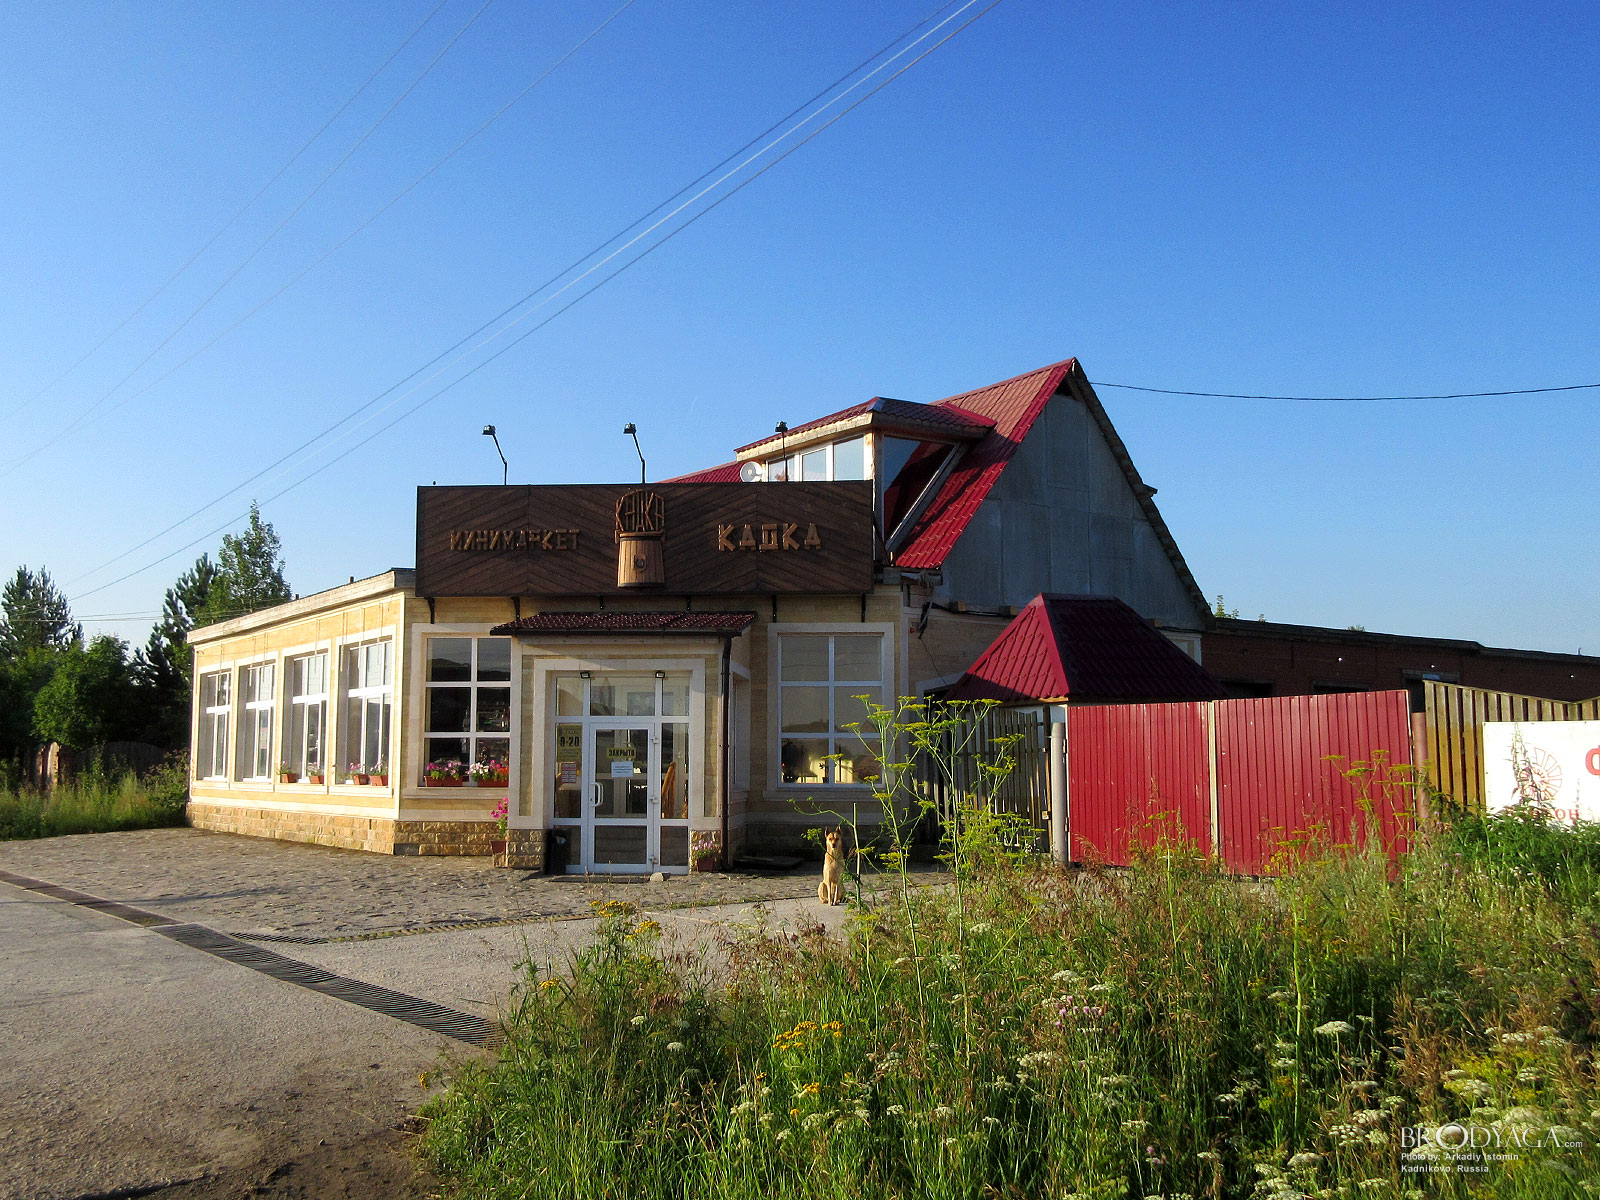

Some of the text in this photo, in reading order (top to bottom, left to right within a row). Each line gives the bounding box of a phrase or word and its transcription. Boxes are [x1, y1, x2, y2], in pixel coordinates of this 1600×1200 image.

[450, 522, 821, 551] МИНИМАРКЕТ КАДКА
[609, 749, 635, 757] ЗАКРЫТО
